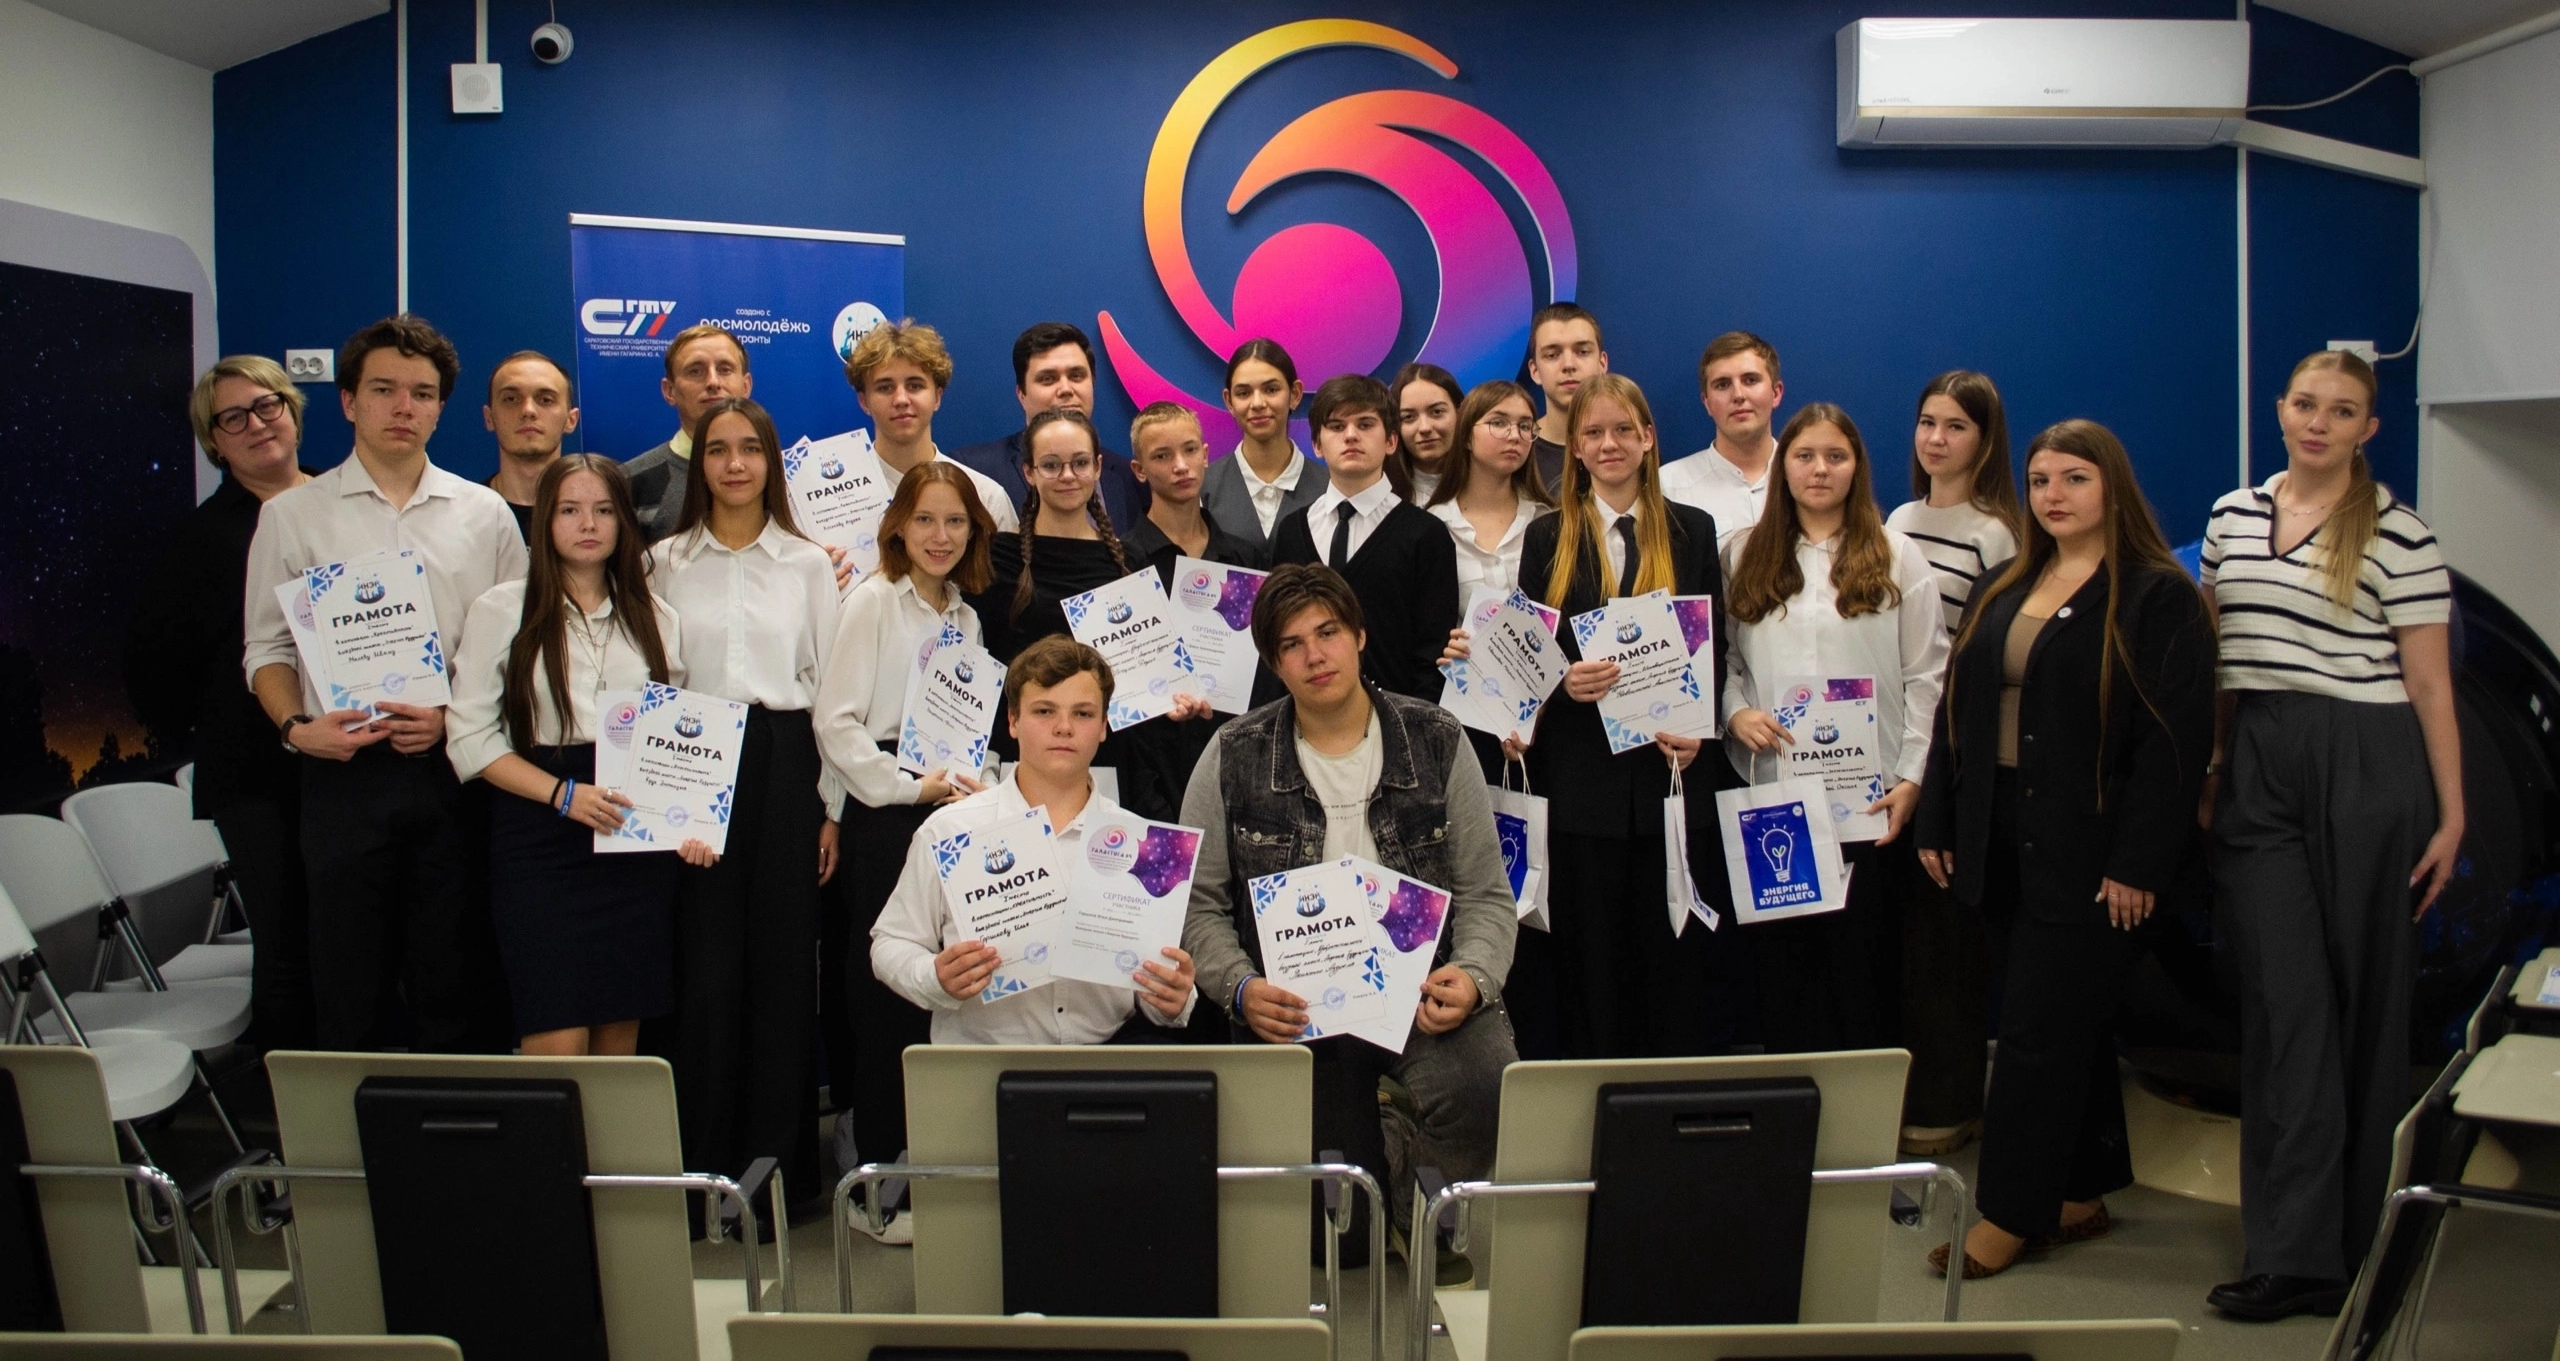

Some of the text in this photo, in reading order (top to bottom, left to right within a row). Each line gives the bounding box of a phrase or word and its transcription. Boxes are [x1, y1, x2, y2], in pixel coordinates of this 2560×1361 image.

[735, 308, 771, 317] создано с
[806, 476, 872, 501] ГРАМОТА
[332, 602, 416, 628] ГРАМОТА
[1092, 616, 1161, 648] ГРАМОТА
[1191, 624, 1232, 638] СЕРТИФИКАТ
[1503, 622, 1545, 681] ГРАМОТА
[934, 669, 983, 711] ГРАМОТА
[646, 735, 723, 761] ГРАМОТА
[1792, 746, 1865, 762] ГРАМОТА
[965, 867, 1049, 904] ГРАМОТА
[1758, 890, 1816, 906] БУДУЩЕГО
[1762, 882, 1809, 897] ЭНЕРГИЯ
[1102, 891, 1152, 906] СЕРТИФИКАТ
[1275, 915, 1356, 942] ГРАМОТА
